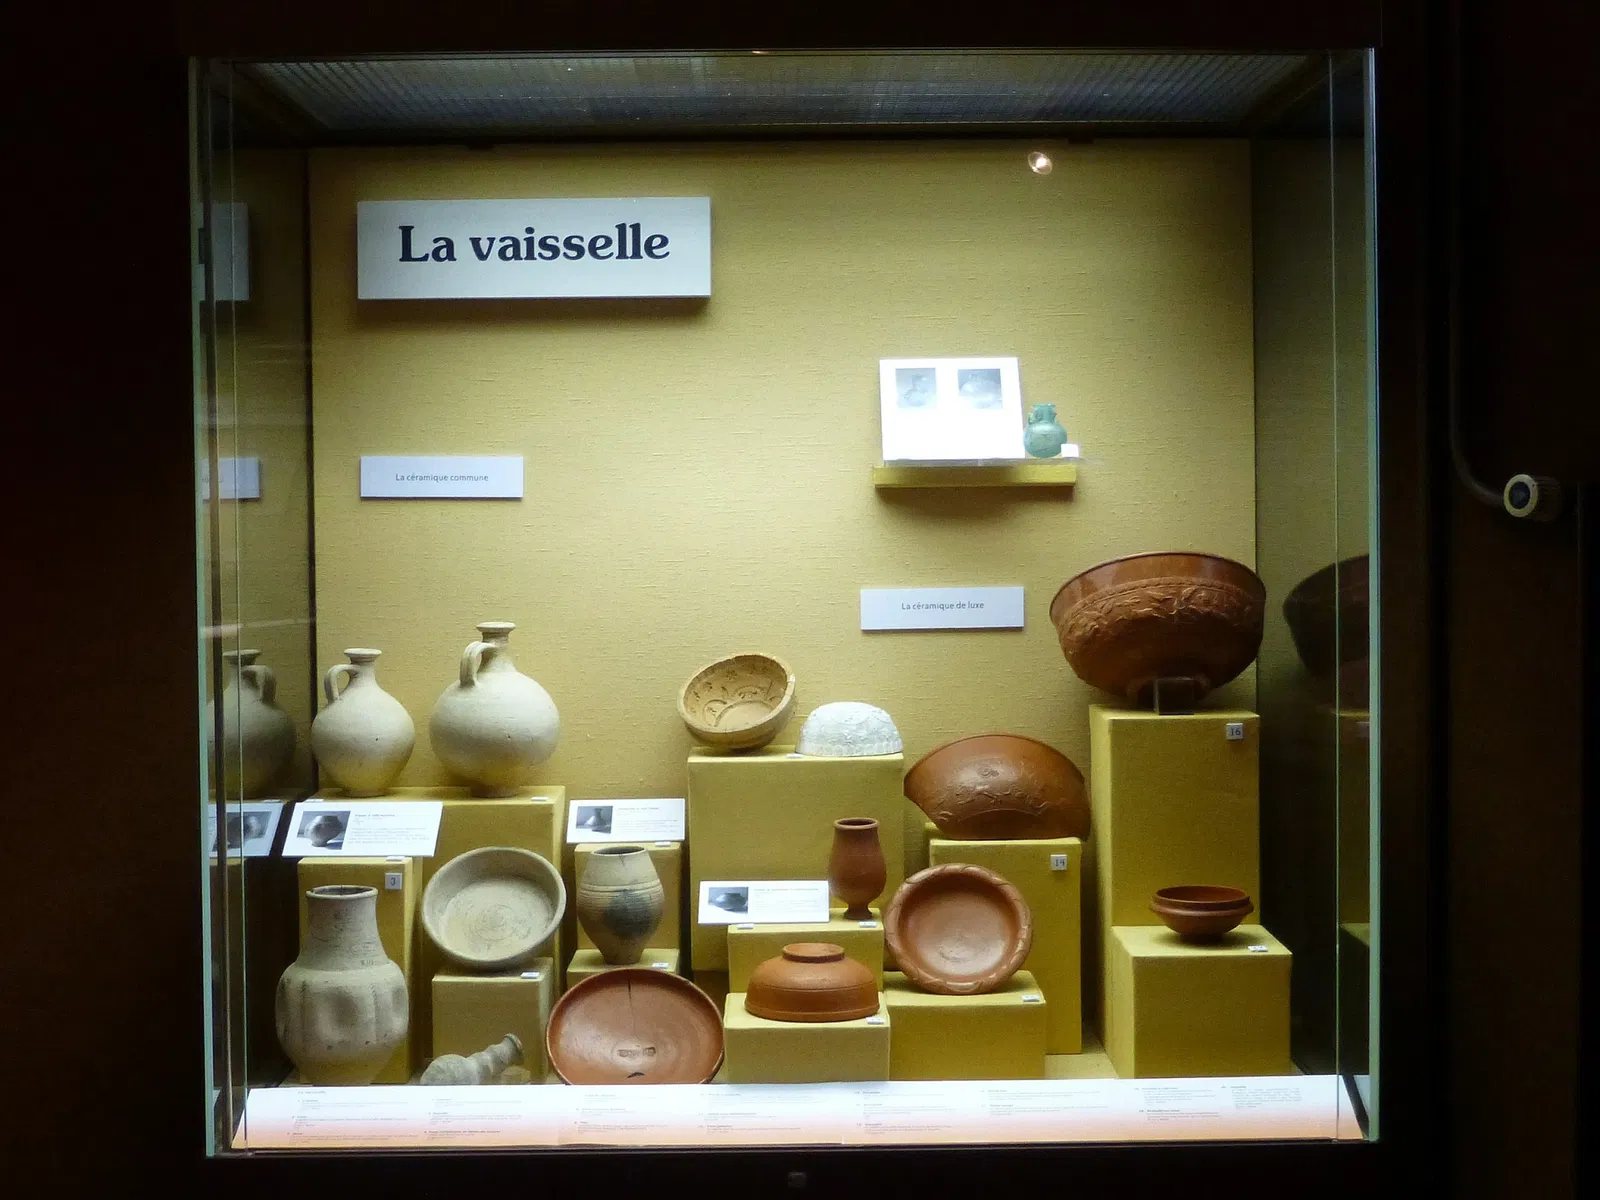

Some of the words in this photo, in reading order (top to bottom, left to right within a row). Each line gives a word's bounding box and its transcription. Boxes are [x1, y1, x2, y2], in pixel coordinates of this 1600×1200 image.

[398, 226, 457, 263] La
[469, 222, 670, 263] vaisselle
[395, 473, 405, 482] La
[406, 473, 448, 483] céramique
[450, 474, 489, 482] commune
[901, 602, 911, 610] La
[912, 602, 955, 612] céramique
[956, 601, 966, 609] de
[967, 601, 984, 609] luxe
[1231, 728, 1241, 736] 16
